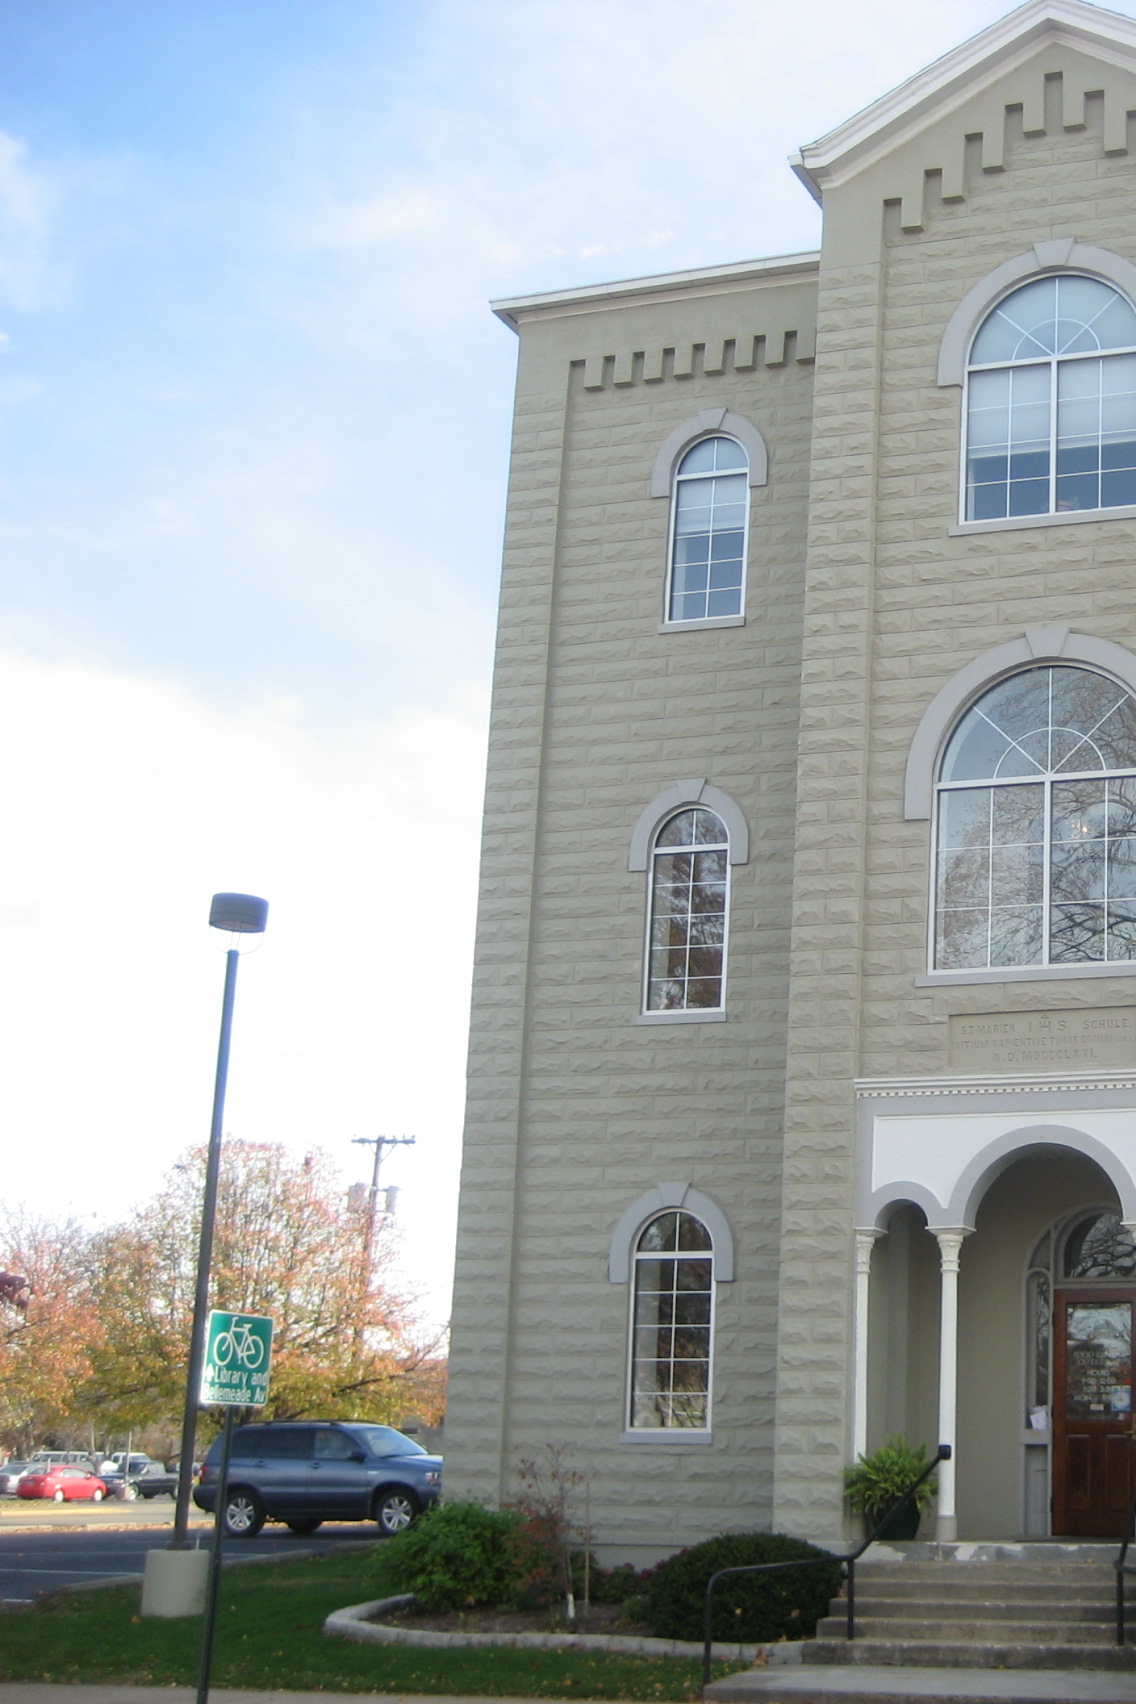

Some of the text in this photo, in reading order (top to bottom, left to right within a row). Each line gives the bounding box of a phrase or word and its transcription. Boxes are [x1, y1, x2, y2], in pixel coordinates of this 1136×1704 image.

[977, 1023, 1016, 1035] MARIEN
[213, 1365, 268, 1388] Library and
[203, 1382, 267, 1403] Bellemeade Av
